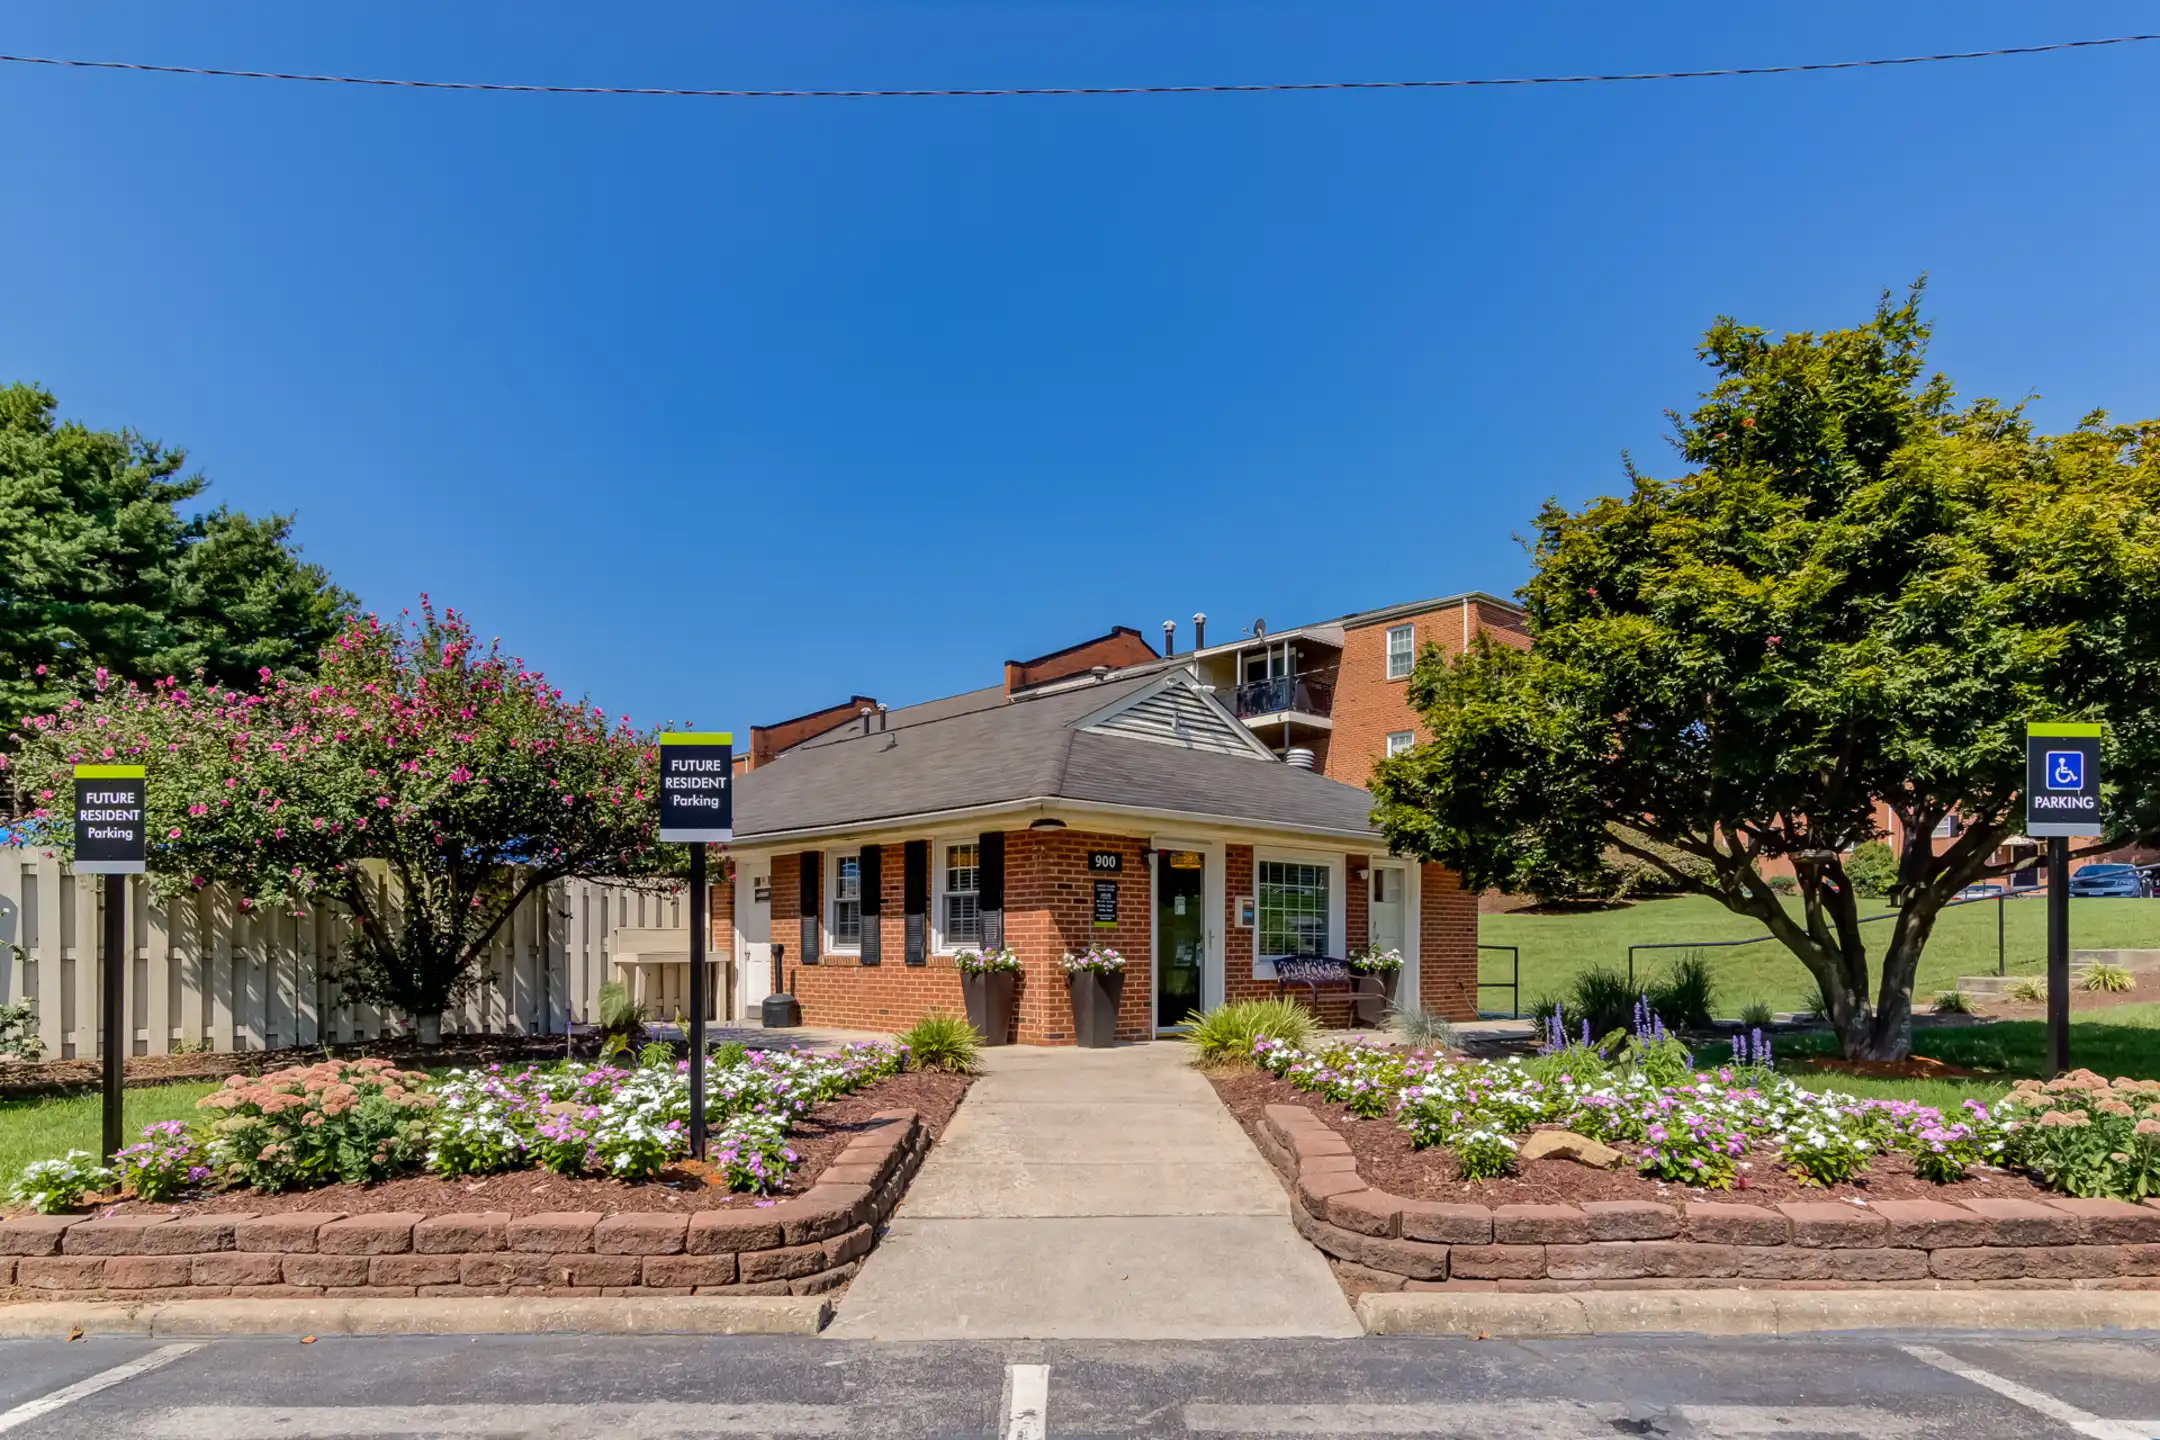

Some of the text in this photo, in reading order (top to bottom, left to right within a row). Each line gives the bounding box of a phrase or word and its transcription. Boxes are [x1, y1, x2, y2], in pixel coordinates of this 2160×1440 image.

[671, 760, 721, 771] FUTURE
[665, 777, 727, 789] RESIDENT
[86, 792, 135, 804] FUTURE
[673, 794, 719, 809] Parking
[2034, 796, 2095, 809] PARKING
[80, 810, 140, 821] RESIDENT
[88, 827, 133, 841] Parking
[1095, 855, 1116, 868] 900
